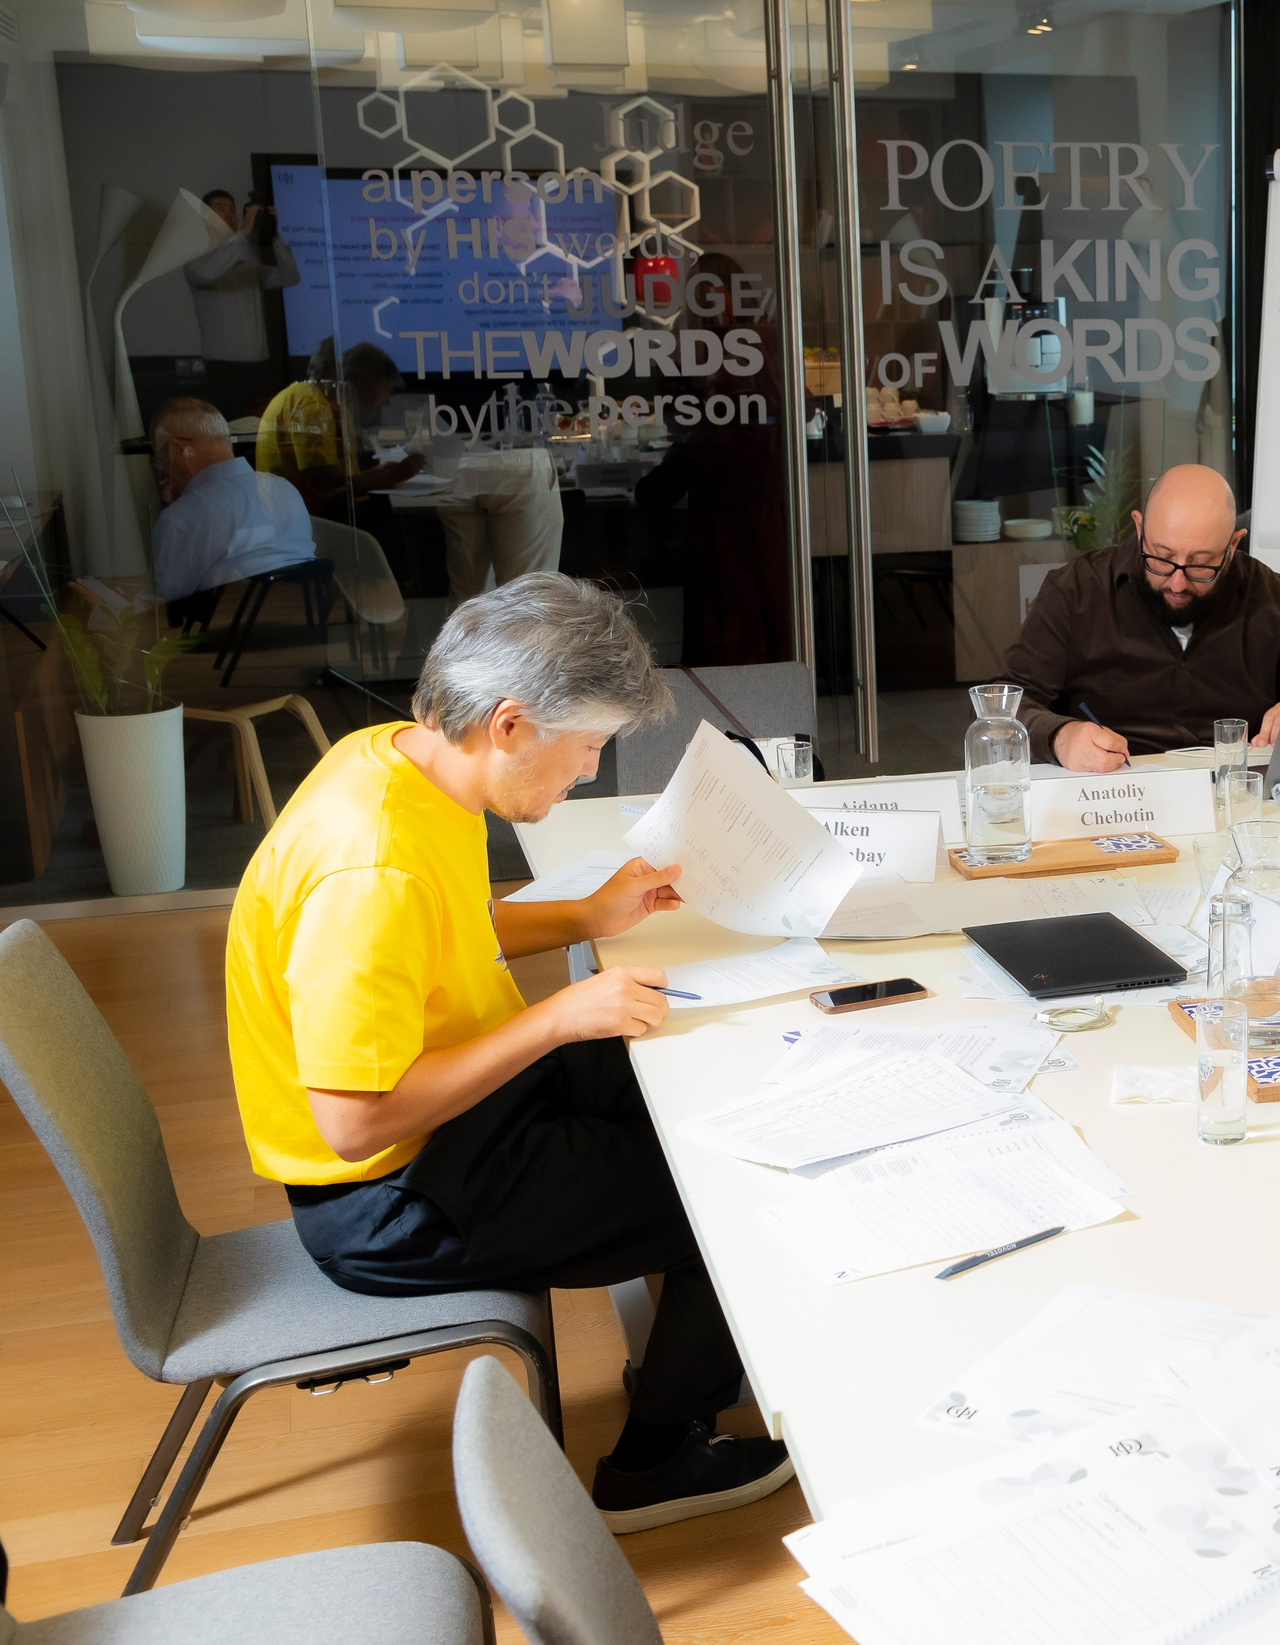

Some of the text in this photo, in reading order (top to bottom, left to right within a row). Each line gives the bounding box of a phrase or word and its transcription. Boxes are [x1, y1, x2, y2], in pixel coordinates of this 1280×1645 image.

[411, 169, 603, 214] person
[877, 139, 1220, 212] POETRY
[370, 218, 427, 272] by
[446, 218, 536, 260] HIS
[880, 239, 1220, 305] IS A KING
[565, 273, 765, 318] JUDGE
[878, 317, 1221, 388] OF WORDS
[589, 393, 767, 437] person
[1078, 784, 1145, 801] Anatoliy
[1081, 808, 1154, 826] Chebotin
[985, 1242, 1017, 1258] NOVOTEL
